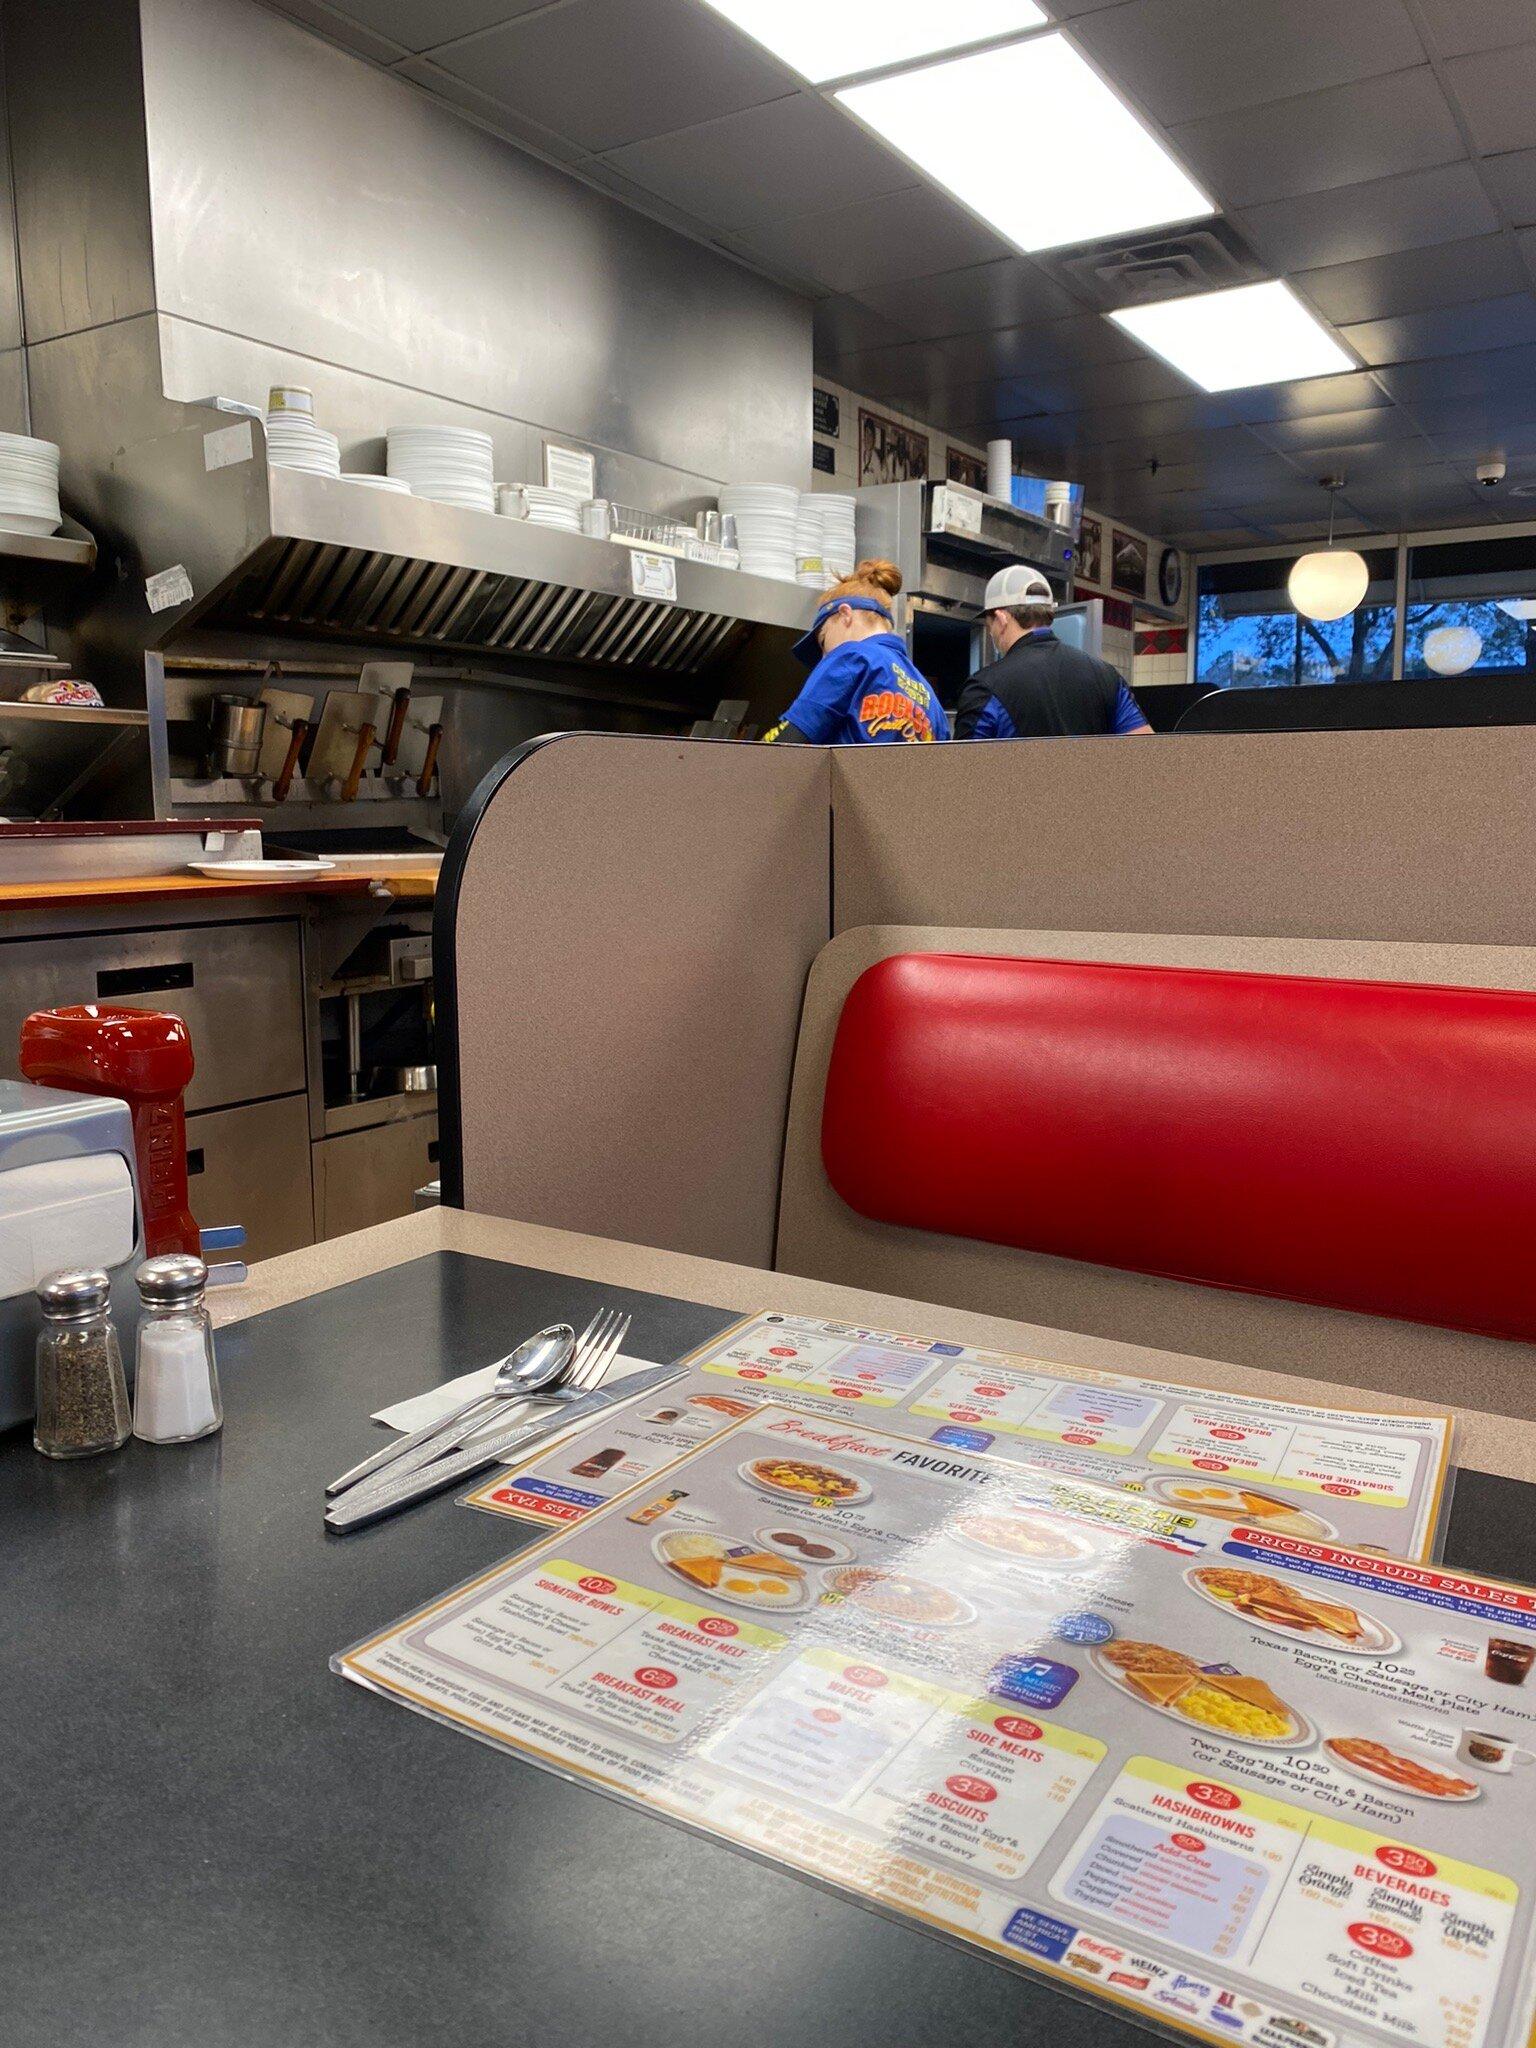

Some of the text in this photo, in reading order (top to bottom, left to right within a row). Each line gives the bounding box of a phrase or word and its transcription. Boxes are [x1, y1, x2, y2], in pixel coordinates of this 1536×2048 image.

[767, 1419, 892, 1457] Breakfast
[893, 1451, 1006, 1486] FAVORITE
[502, 1492, 583, 1520] LES TAX
[1244, 1531, 1519, 1605] PRICES INCLUDE SALES
[1255, 1555, 1288, 1567] server
[1288, 1562, 1311, 1573] who
[1310, 1568, 1357, 1588] prepares
[1358, 1579, 1377, 1589] the
[1376, 1583, 1407, 1597] order
[1406, 1589, 1430, 1602] and
[534, 1578, 624, 1617] SIGNATURE BOWLS
[1313, 1561, 1347, 1576] added
[1346, 1569, 1360, 1578] to
[1458, 1598, 1484, 1610] 10%
[1496, 1608, 1523, 1619] paid
[656, 1622, 717, 1650] BREAKFAST
[716, 1642, 748, 1658] MELT
[1250, 1635, 1536, 1721] Texas Bacon (or Sausage or City Ham)
[1374, 1660, 1417, 1677] 1025
[591, 1672, 655, 1701] BREAKFAST
[654, 1695, 686, 1714] MEAL
[1342, 1670, 1399, 1694] Cheese
[1401, 1686, 1437, 1703] Melt
[1439, 1699, 1482, 1717] Plate
[966, 1728, 1045, 1764] SIDE MEATS
[980, 1747, 1016, 1765] Bacon
[959, 1759, 1013, 1784] City Ham
[968, 1753, 1016, 1775] Sausage
[1190, 1736, 1222, 1754] Two
[1259, 1760, 1342, 1793] Breakfast
[1343, 1788, 1357, 1798] &
[1361, 1793, 1416, 1817] Bacon
[1283, 1755, 1331, 1774] 1050
[1192, 1750, 1403, 1825] (or Sausage or City Ham)
[1194, 1785, 1234, 1805] 375
[923, 1806, 940, 1816] (or
[940, 1812, 980, 1833] Bacon)
[926, 1791, 989, 1824] BISCUITS
[1152, 1794, 1256, 1839] HASHBROWNS
[939, 1823, 980, 1844] Biscuit
[1113, 1797, 1174, 1823] Scattered
[1174, 1818, 1255, 1853] Hashbrowns
[926, 1834, 937, 1843] &
[940, 1840, 977, 1860] Gravy
[1100, 1844, 1143, 1864] Covered
[1104, 1835, 1159, 1860] Smothered
[1153, 1841, 1213, 1869] Add-Ons
[1386, 1849, 1429, 1869] 350
[1088, 1860, 1119, 1878] Diced
[1095, 1852, 1138, 1873] Chunked
[1302, 1862, 1354, 1890] Simply
[1078, 1879, 1120, 1900] Capped
[1083, 1870, 1133, 1894] Peppered
[1298, 1874, 1353, 1899] Orange
[1352, 1864, 1452, 1908] BEVERAGES
[1371, 1886, 1424, 1914] Simply
[1358, 1926, 1405, 1949] 300
[1440, 1910, 1496, 1939] Simply
[1443, 1924, 1489, 1949] Apple
[1130, 1957, 1171, 1980] HEINZ
[1326, 1953, 1414, 1993] Soft Drinks
[1348, 1949, 1399, 1974] Coffee
[1333, 1968, 1399, 1999] Iced Tea
[1344, 1984, 1379, 2004] Milk
[1300, 1980, 1378, 2018] Chocolate
[1381, 2011, 1418, 2034] Milk
